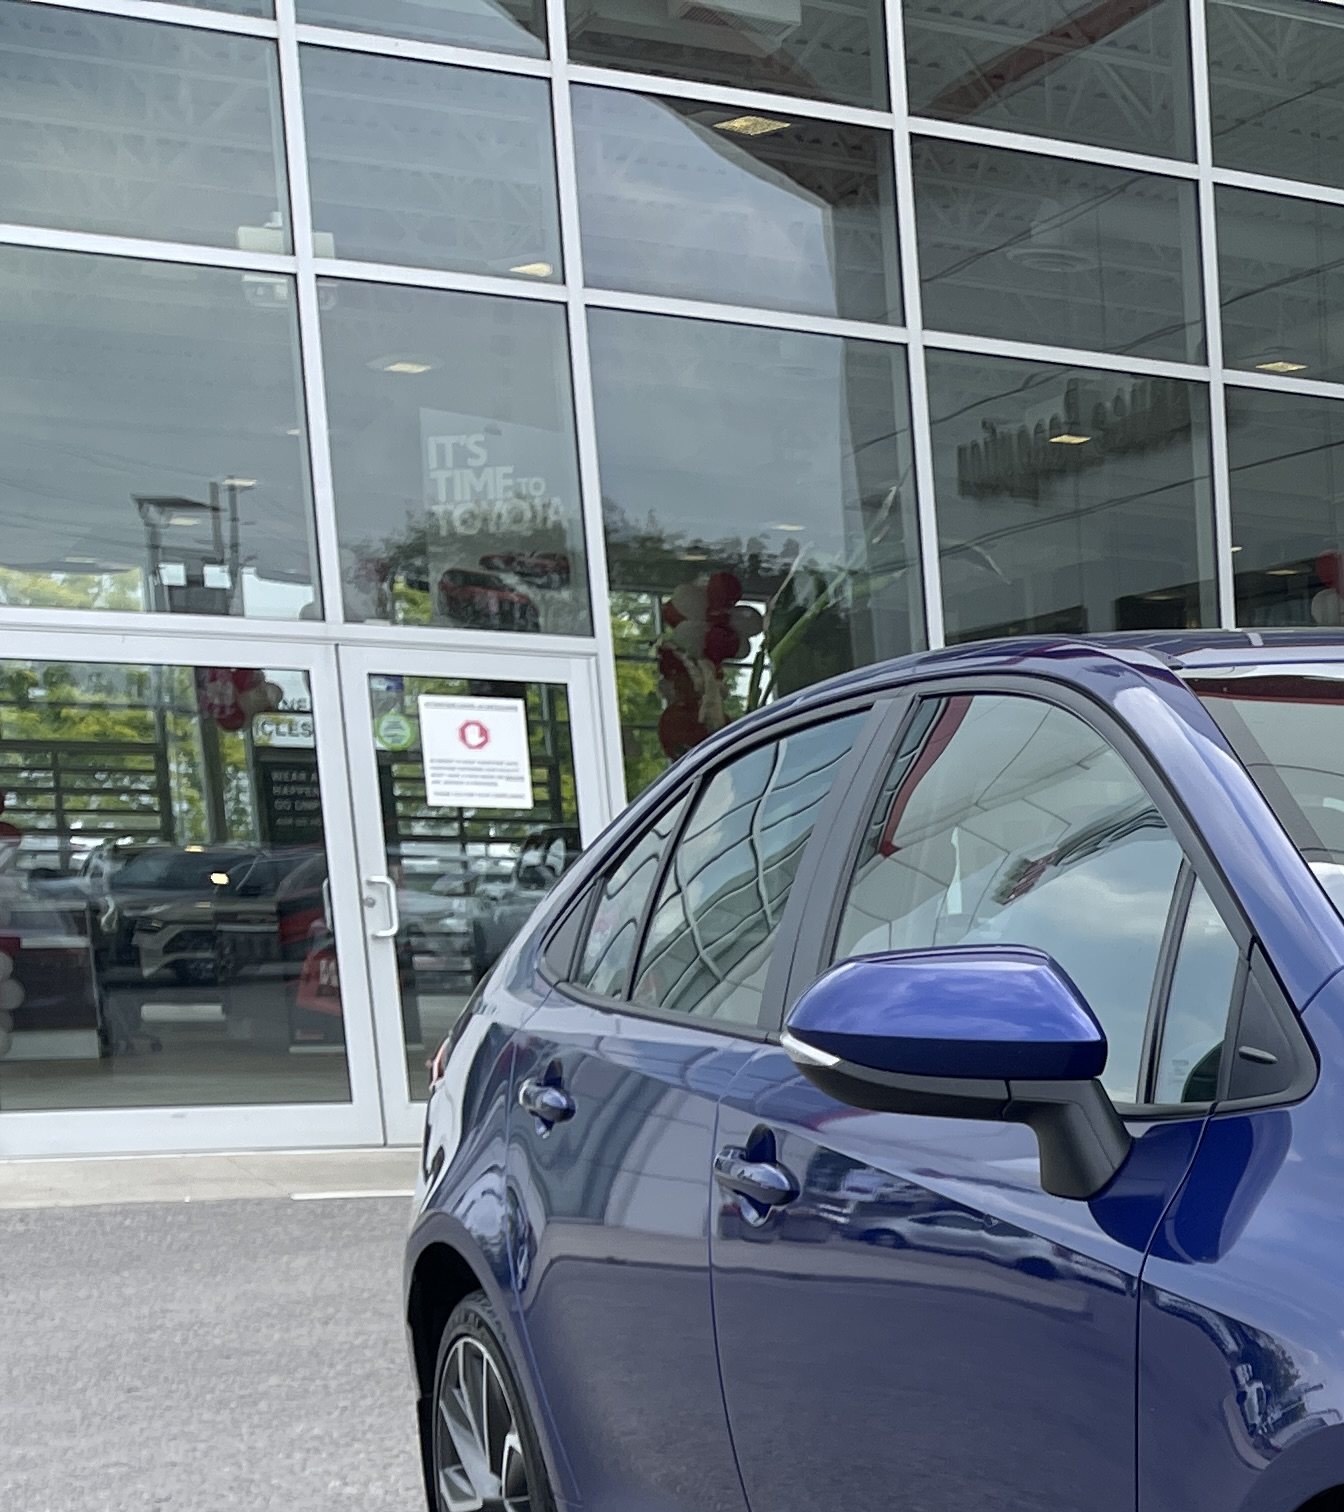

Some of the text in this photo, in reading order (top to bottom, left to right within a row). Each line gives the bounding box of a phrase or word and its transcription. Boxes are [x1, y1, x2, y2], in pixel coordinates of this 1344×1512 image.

[428, 433, 487, 469] IT'S
[430, 465, 546, 503] TIME TO
[432, 497, 569, 537] TOYOTA
